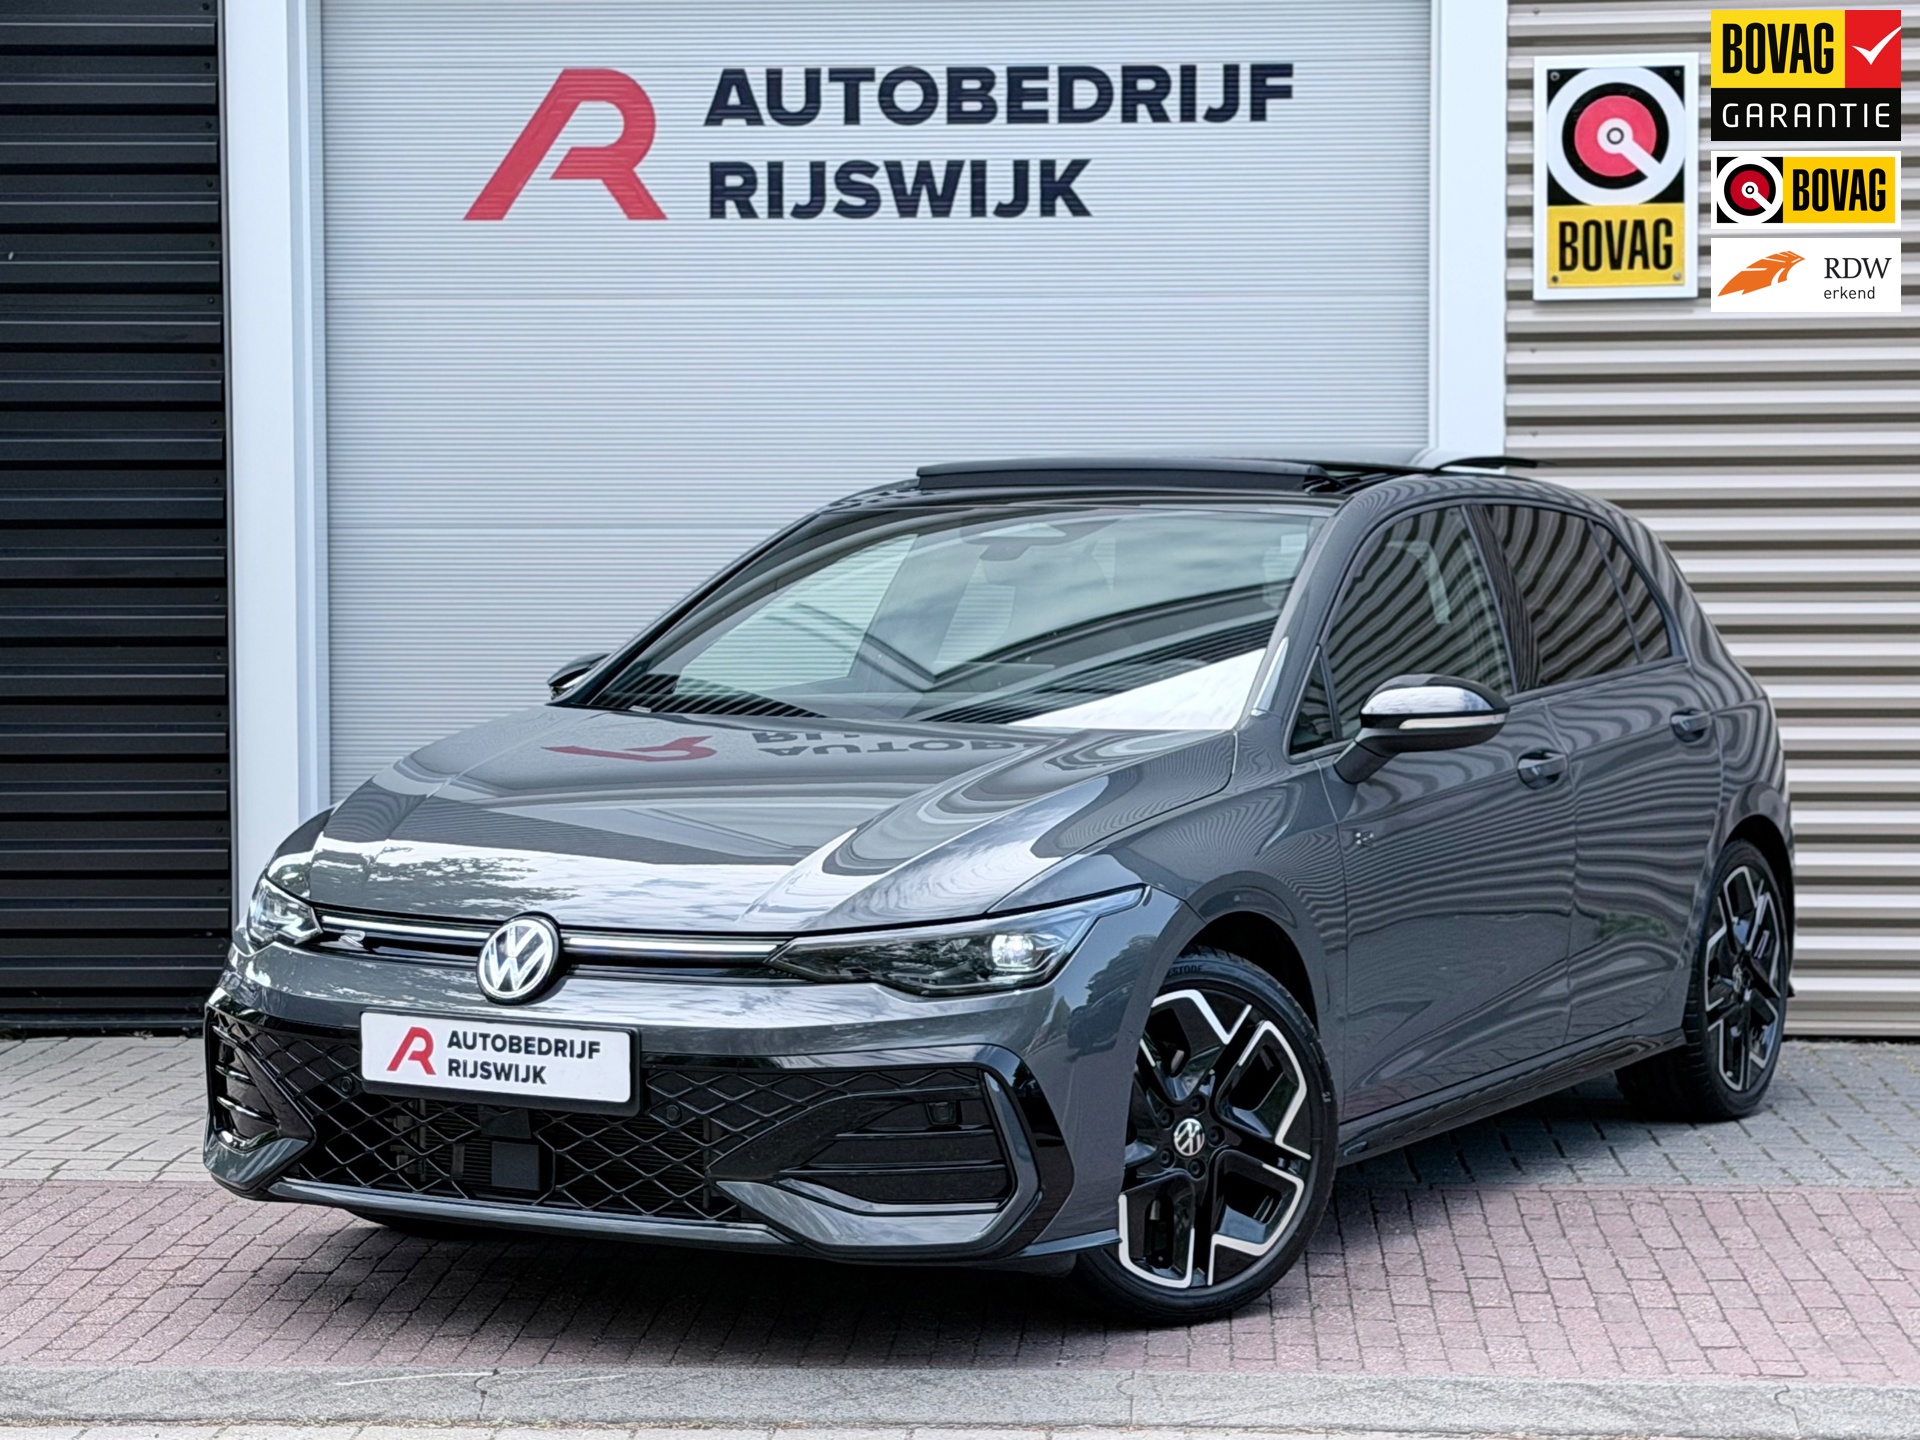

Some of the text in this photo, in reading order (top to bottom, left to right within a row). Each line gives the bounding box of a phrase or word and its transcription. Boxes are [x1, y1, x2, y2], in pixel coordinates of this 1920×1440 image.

[703, 63, 1294, 126] AUTOBEDRIJF
[708, 159, 1092, 219] RIJSWIJK
[1558, 218, 1674, 272] BOVAG
[446, 1030, 601, 1060] AUTOBEDRIJF
[447, 1058, 547, 1085] RIJSWIJK
